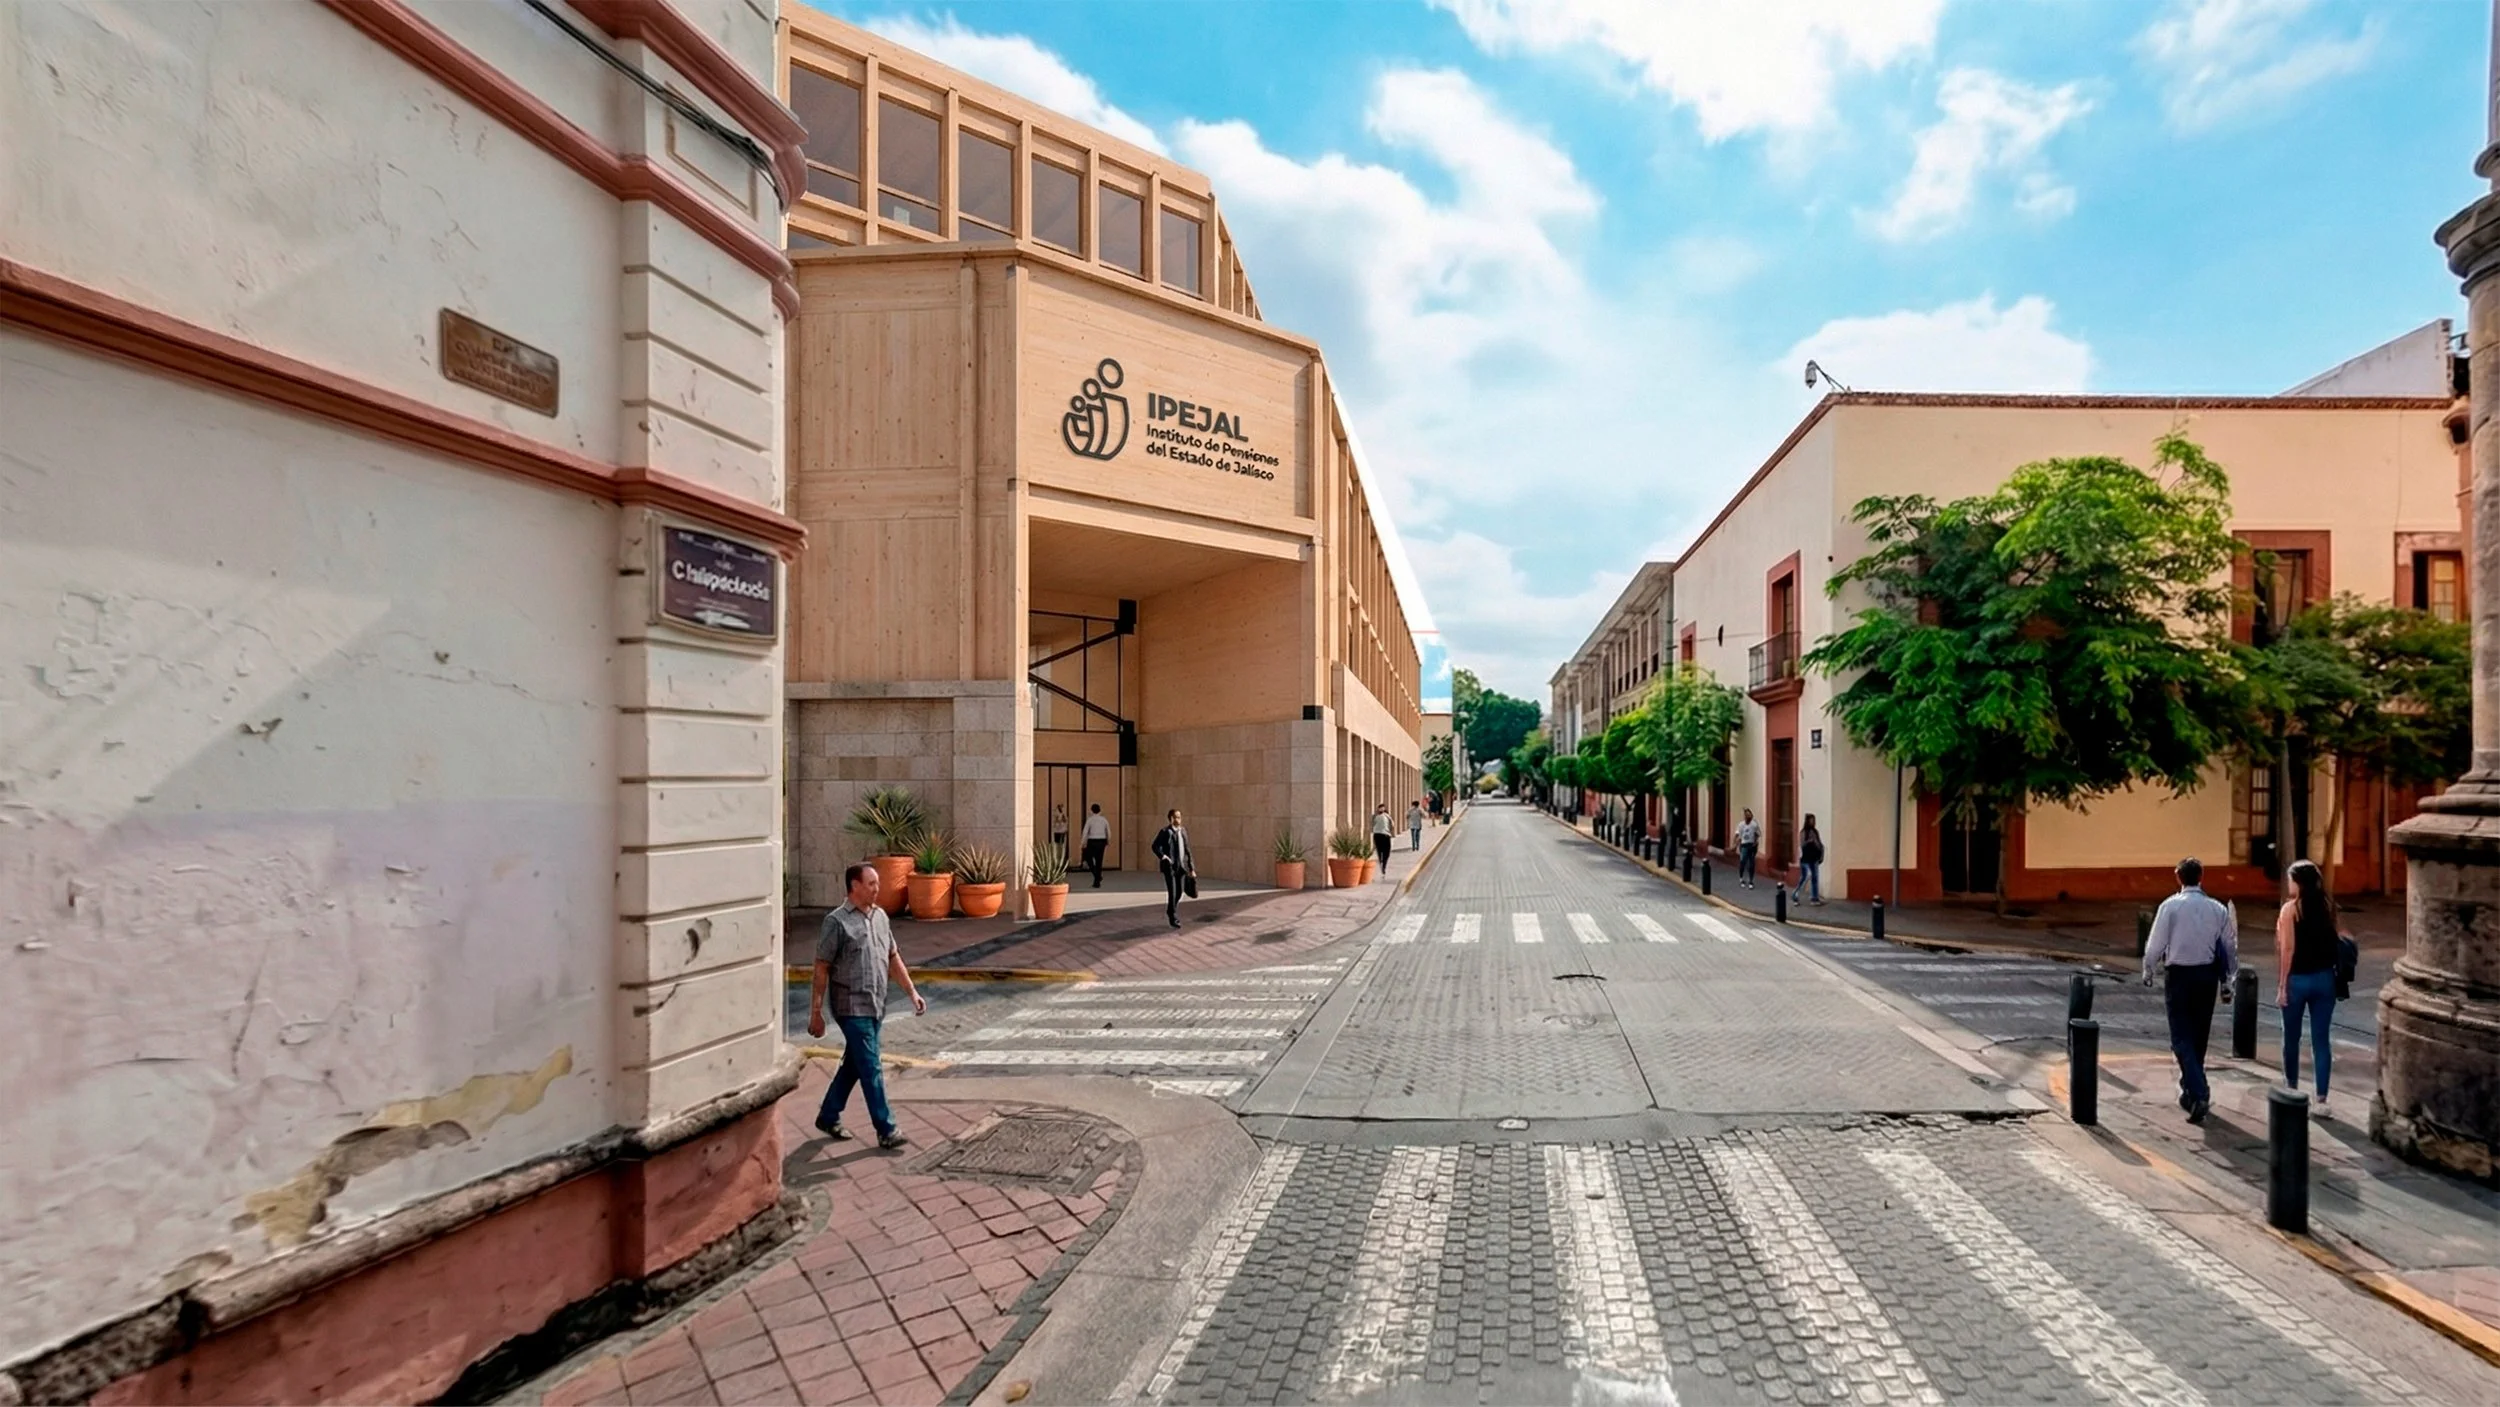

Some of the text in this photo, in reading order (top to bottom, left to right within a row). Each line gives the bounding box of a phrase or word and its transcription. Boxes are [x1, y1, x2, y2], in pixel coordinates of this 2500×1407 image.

[1148, 392, 1249, 442] IPEJAL
[1146, 424, 1279, 466] Instituto de Pensiones
[1146, 441, 1167, 457] del
[1170, 446, 1213, 467] Estado
[1215, 457, 1231, 472] de
